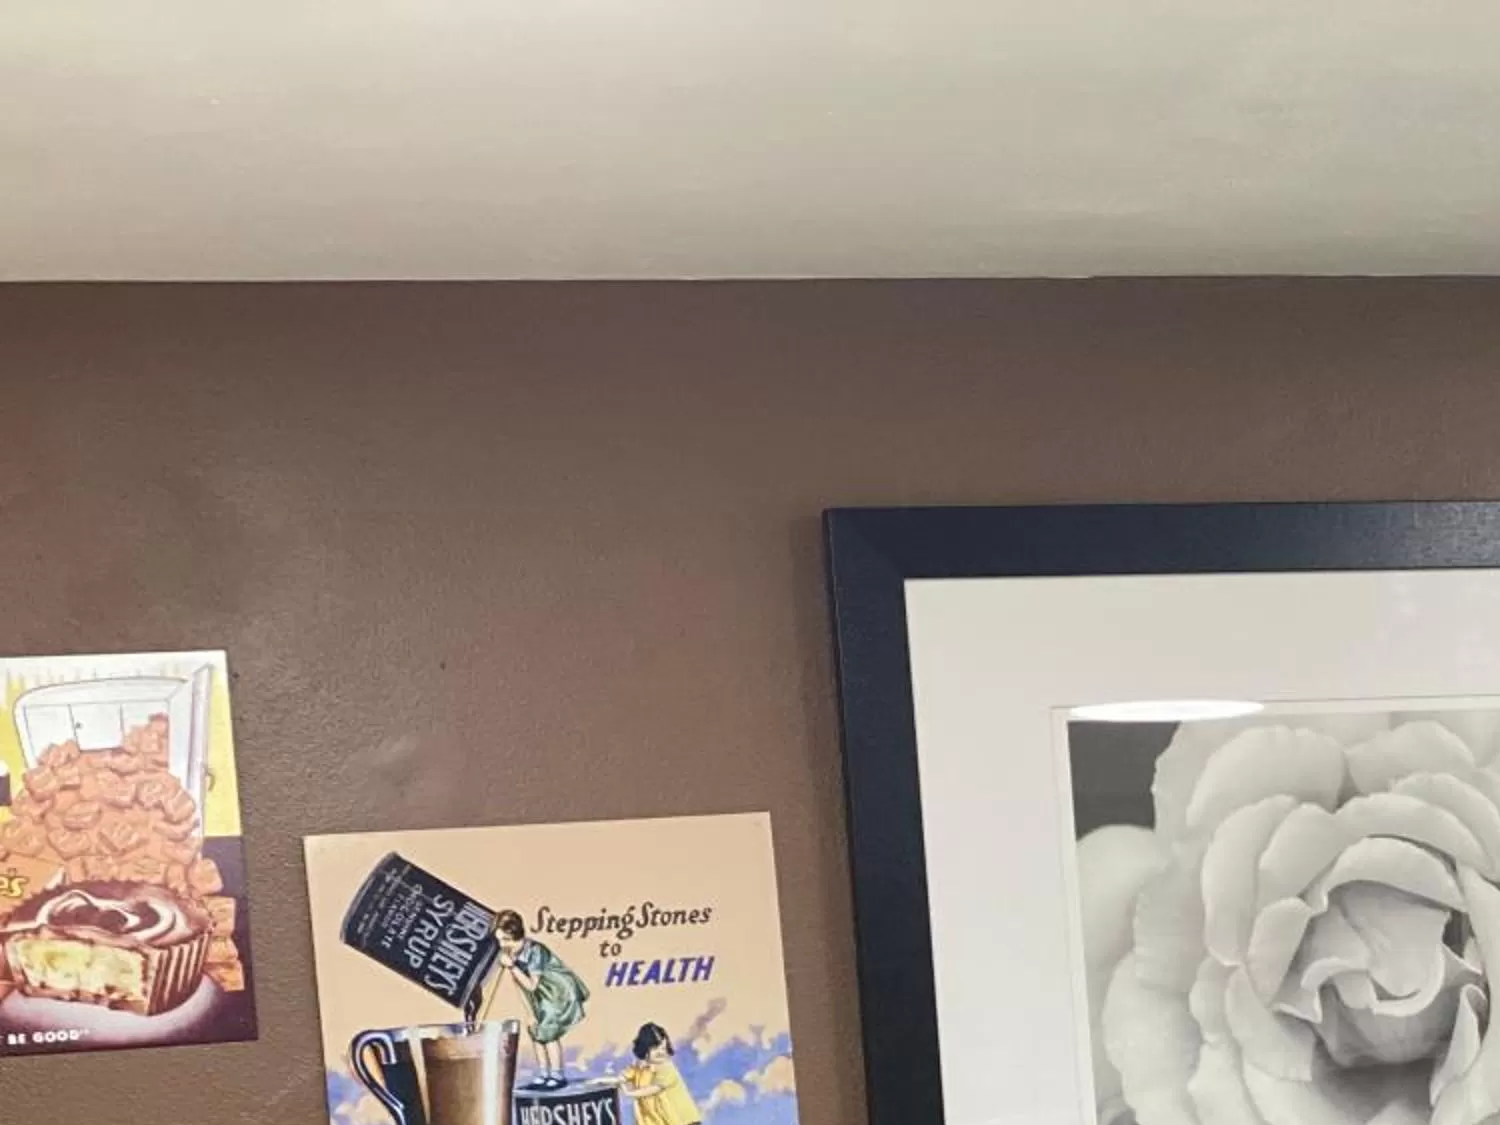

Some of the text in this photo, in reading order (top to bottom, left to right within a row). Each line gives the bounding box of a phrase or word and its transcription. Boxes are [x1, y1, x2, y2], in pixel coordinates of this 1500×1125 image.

[403, 894, 455, 969] SYRUP
[530, 900, 713, 940] Stepping Stones
[599, 939, 623, 958] to
[604, 955, 715, 988] HEALTH
